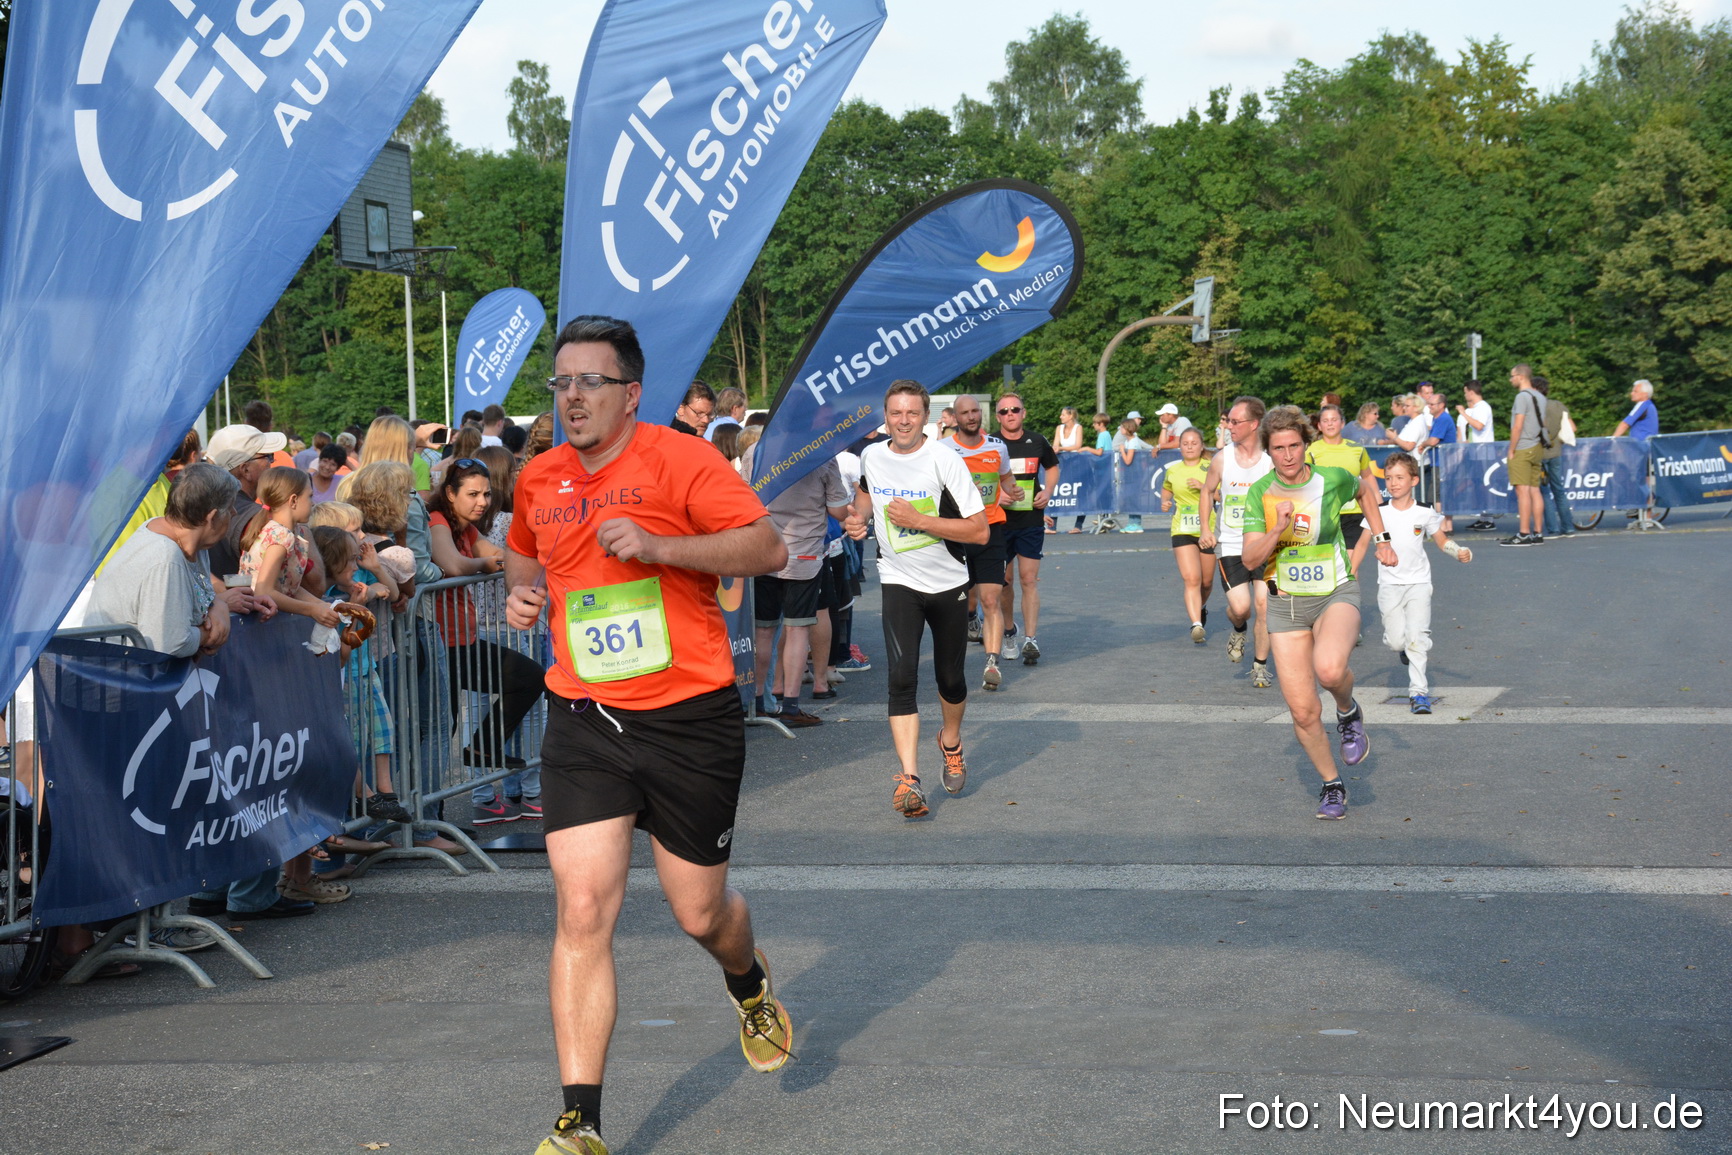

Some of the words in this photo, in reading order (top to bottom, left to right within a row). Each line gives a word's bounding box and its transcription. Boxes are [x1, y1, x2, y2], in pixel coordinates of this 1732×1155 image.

[706, 14, 836, 239] AUTOMOBILE
[931, 316, 978, 351] Druck
[979, 298, 1011, 321] und
[1008, 264, 1065, 306] Medien
[476, 305, 526, 383] Fischer
[495, 319, 532, 381] AUTOMOBILE
[804, 278, 999, 406] Frischmann
[873, 486, 927, 498] DELPHI
[1564, 490, 1605, 500] OBILE
[1656, 455, 1727, 477] Frischmann
[1288, 565, 1324, 582] 988
[585, 619, 643, 655] 361
[171, 722, 310, 810] Fischer
[185, 788, 288, 850] AUTOMOBILE
